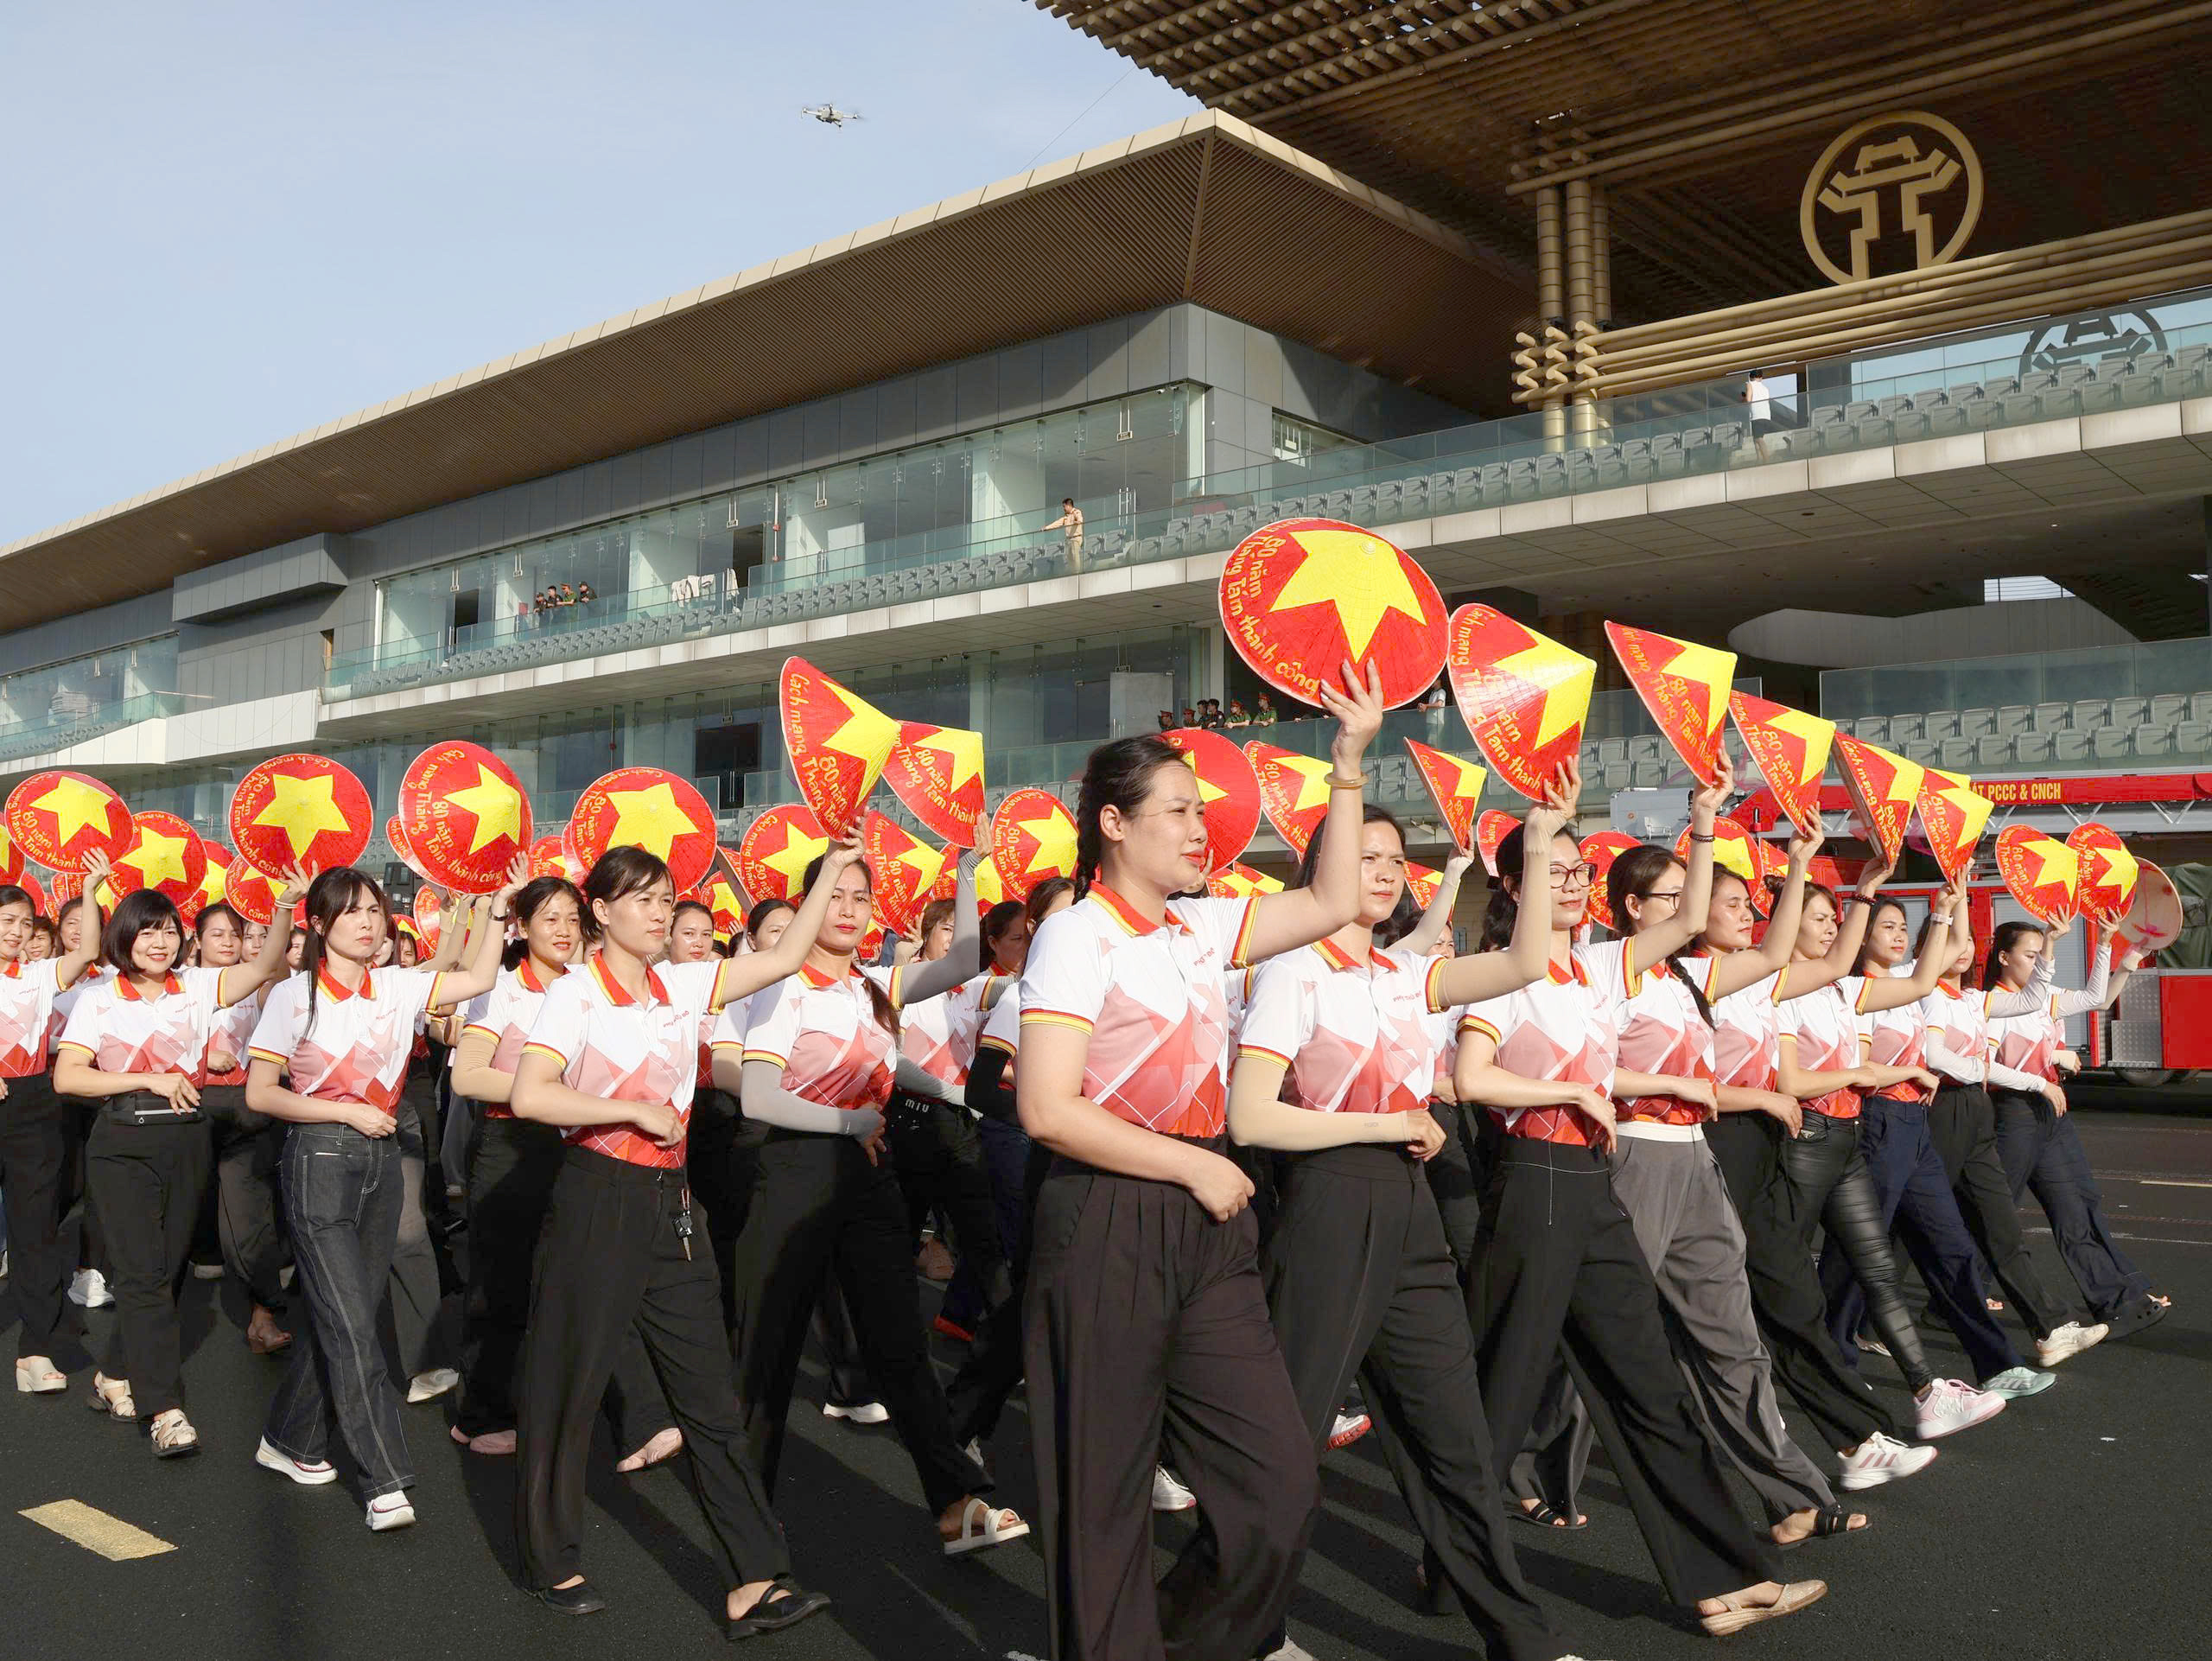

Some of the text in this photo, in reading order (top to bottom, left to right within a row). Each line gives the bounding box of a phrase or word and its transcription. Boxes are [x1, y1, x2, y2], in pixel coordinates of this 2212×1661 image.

[1225, 534, 1273, 576] Tháng
[1249, 537, 1286, 598] 80 năm
[1227, 577, 1249, 616] Tám
[1239, 615, 1279, 664] thành
[790, 673, 810, 707] Cách
[1275, 661, 1321, 697] công
[1669, 678, 1688, 697] 80
[1451, 627, 1472, 666] mạng
[1484, 723, 1510, 762] Tám
[1508, 755, 1542, 791] thành
[787, 710, 808, 757] mạng
[818, 755, 840, 782] 80
[915, 748, 949, 791] 80 năm
[1745, 724, 1770, 767] Tháng
[1767, 761, 1784, 792] Tám
[1763, 730, 1796, 785] 80 năm
[1841, 740, 1865, 767] Cách
[1856, 767, 1878, 806] mạng
[235, 772, 264, 802] Tháng
[245, 773, 270, 816] 80 năm
[407, 763, 439, 790] mạng
[801, 756, 826, 813] Tháng
[895, 746, 976, 824] Tháng Tám thành
[1265, 763, 1291, 809] 80 năm
[1988, 784, 2016, 801] PCCC
[2019, 784, 2028, 800] &
[2031, 782, 2061, 800] CNCH
[410, 791, 433, 837] Tháng
[589, 795, 607, 814] 80
[1884, 805, 1897, 827] 80
[1930, 795, 1947, 816] 80
[10, 809, 25, 843] Tháng
[23, 836, 45, 859] Tám
[47, 851, 78, 872] thành
[22, 811, 54, 850] 80 năm
[431, 800, 454, 849] 80 năm
[755, 815, 779, 833] Cách
[238, 827, 260, 861] thành
[424, 835, 448, 865] Tám
[742, 833, 759, 857] mạng
[996, 849, 1010, 871] Tám
[1007, 827, 1021, 870] 80 năm
[2012, 846, 2024, 862] 80
[2084, 850, 2096, 861] 80
[447, 858, 480, 881] thành
[754, 863, 767, 880] 80
[874, 854, 891, 895] Tháng
[888, 860, 902, 875] 80
